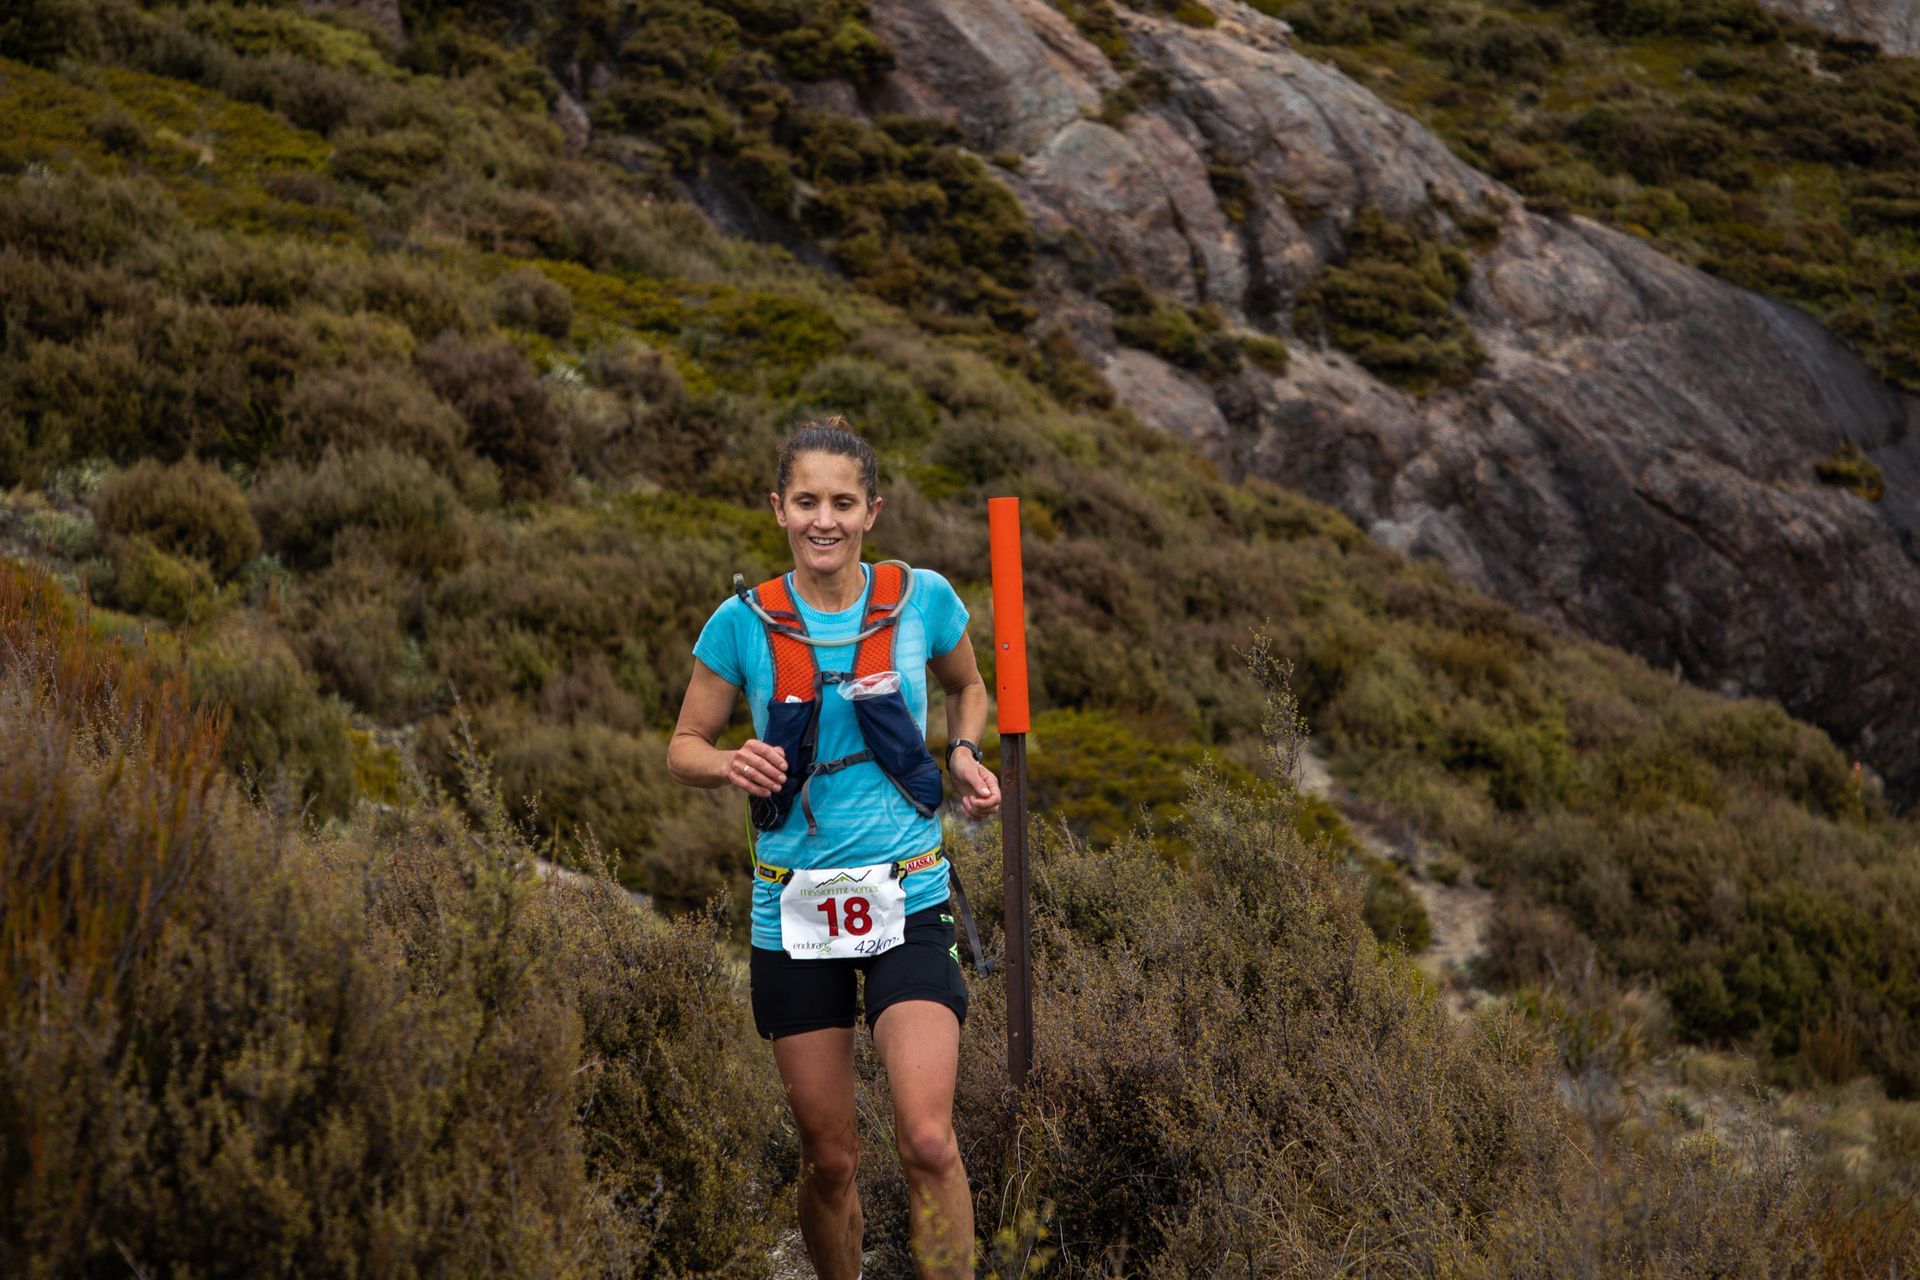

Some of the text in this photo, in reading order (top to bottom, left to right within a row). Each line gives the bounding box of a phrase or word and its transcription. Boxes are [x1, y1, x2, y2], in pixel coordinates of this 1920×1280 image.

[906, 854, 935, 872] ALASKA
[800, 887, 834, 896] mission
[836, 886, 848, 895] mt
[817, 896, 872, 937] 18
